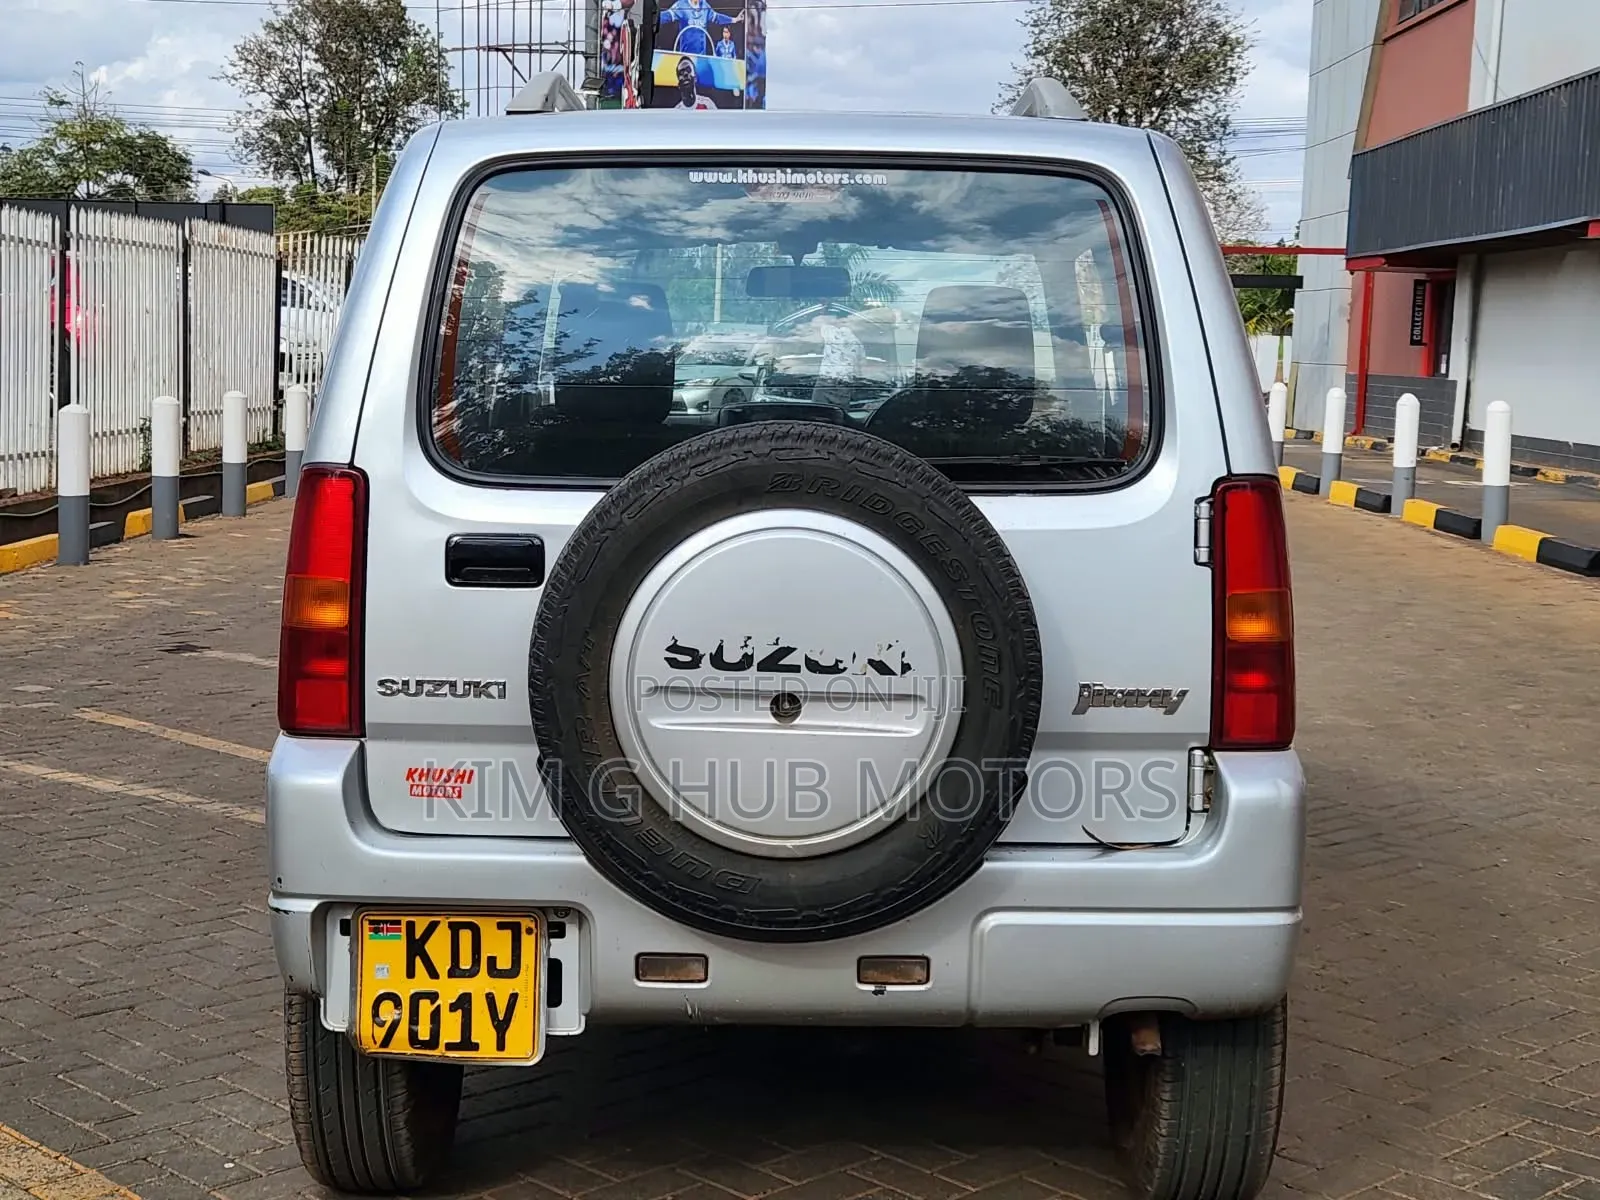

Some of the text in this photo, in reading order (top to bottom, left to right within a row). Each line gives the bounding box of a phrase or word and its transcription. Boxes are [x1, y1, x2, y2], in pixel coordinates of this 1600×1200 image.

[688, 168, 888, 185] www.khushimotors.com
[1413, 307, 1423, 341] COLLECT
[767, 472, 1005, 711] BRIDGESTONE
[376, 677, 507, 700] SUZUKI
[405, 767, 475, 785] KHUSHI
[411, 785, 462, 799] MOTORS
[405, 920, 522, 980] KDJ
[371, 991, 520, 1052] 901Y
